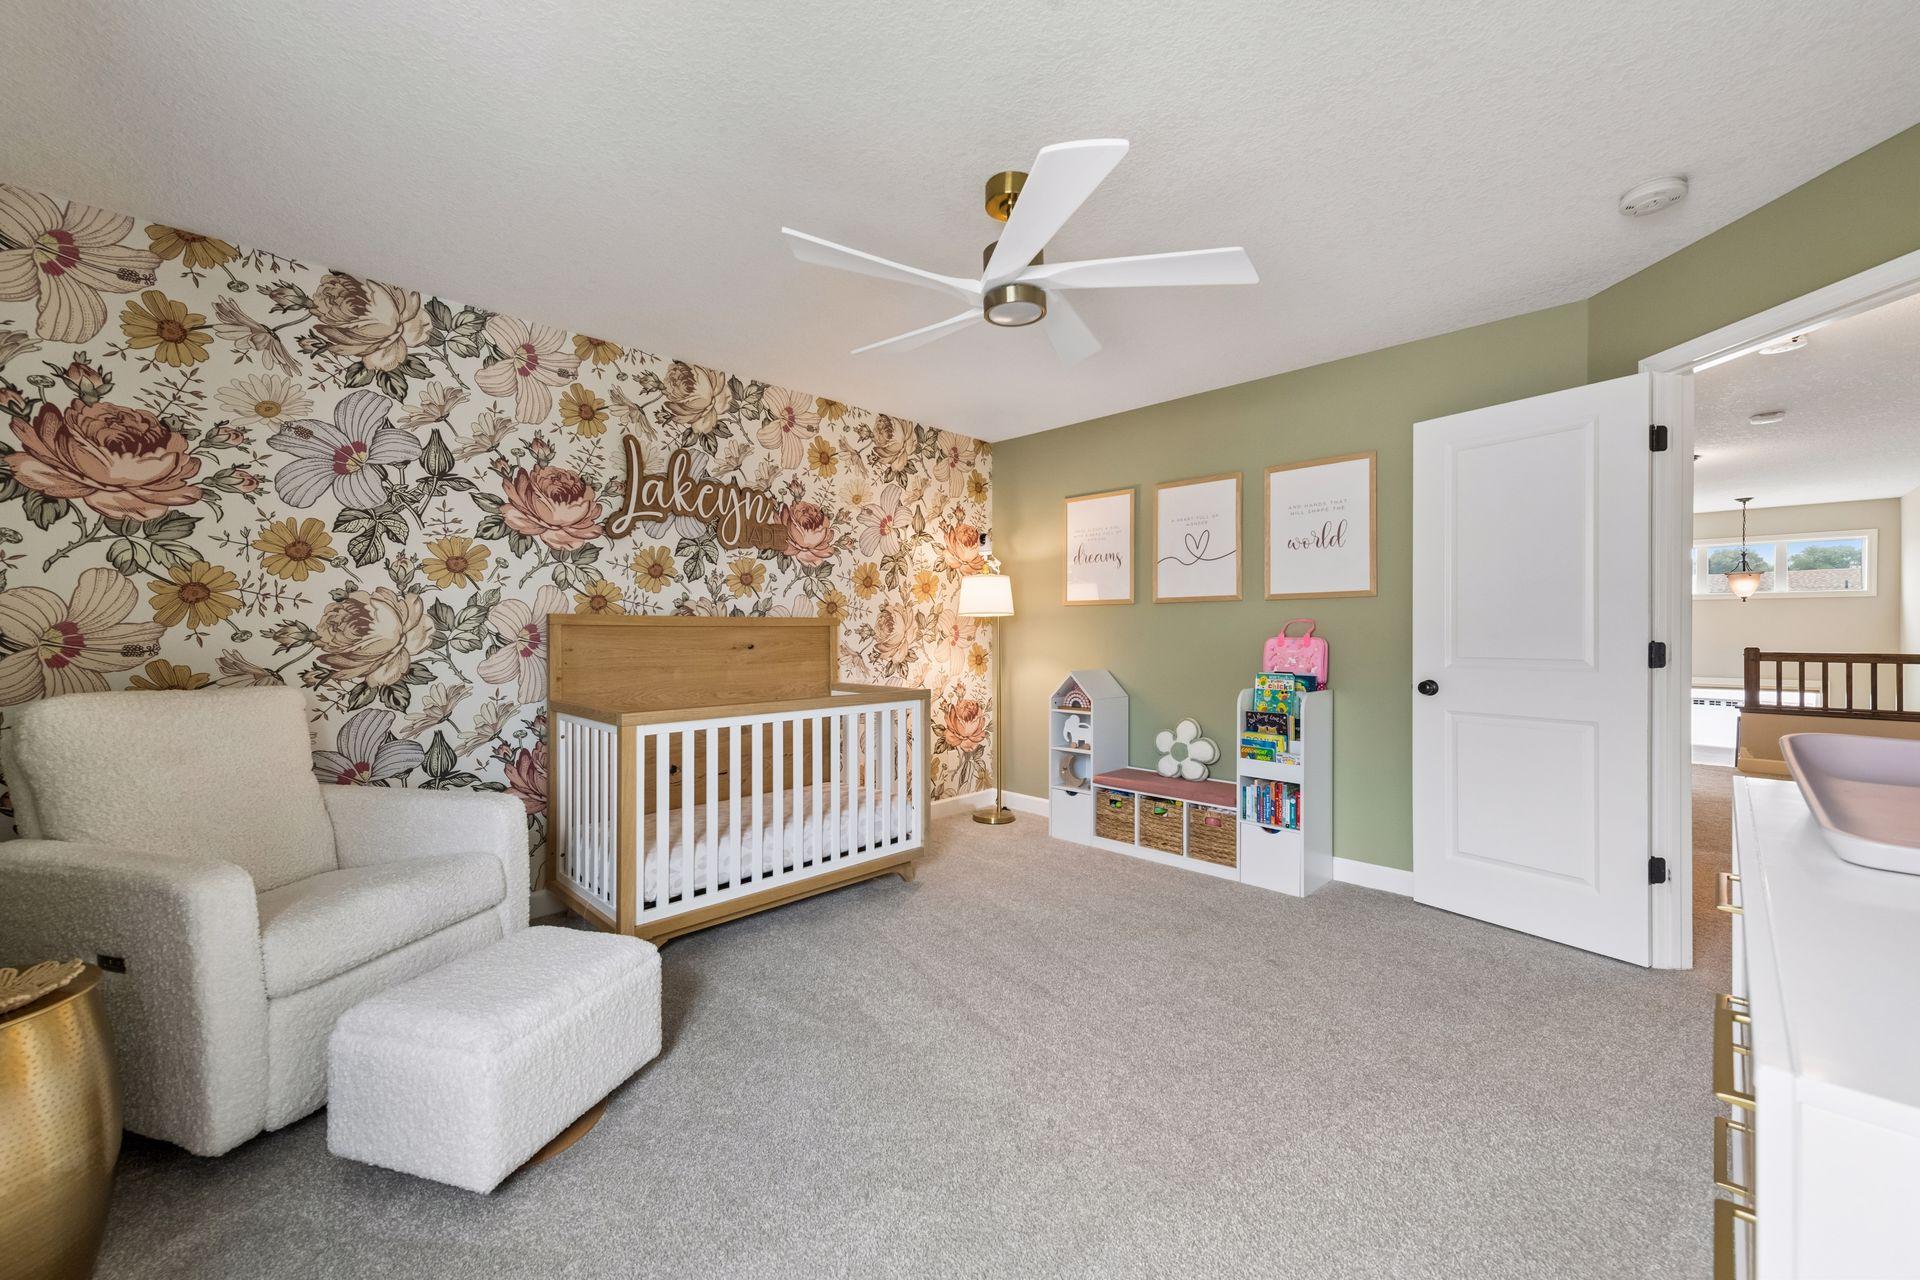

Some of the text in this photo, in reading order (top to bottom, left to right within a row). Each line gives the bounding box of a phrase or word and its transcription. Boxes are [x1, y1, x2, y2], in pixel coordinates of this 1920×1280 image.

[611, 438, 771, 546] Lakeyn
[1287, 518, 1348, 550] world
[1073, 542, 1122, 568] dreams
